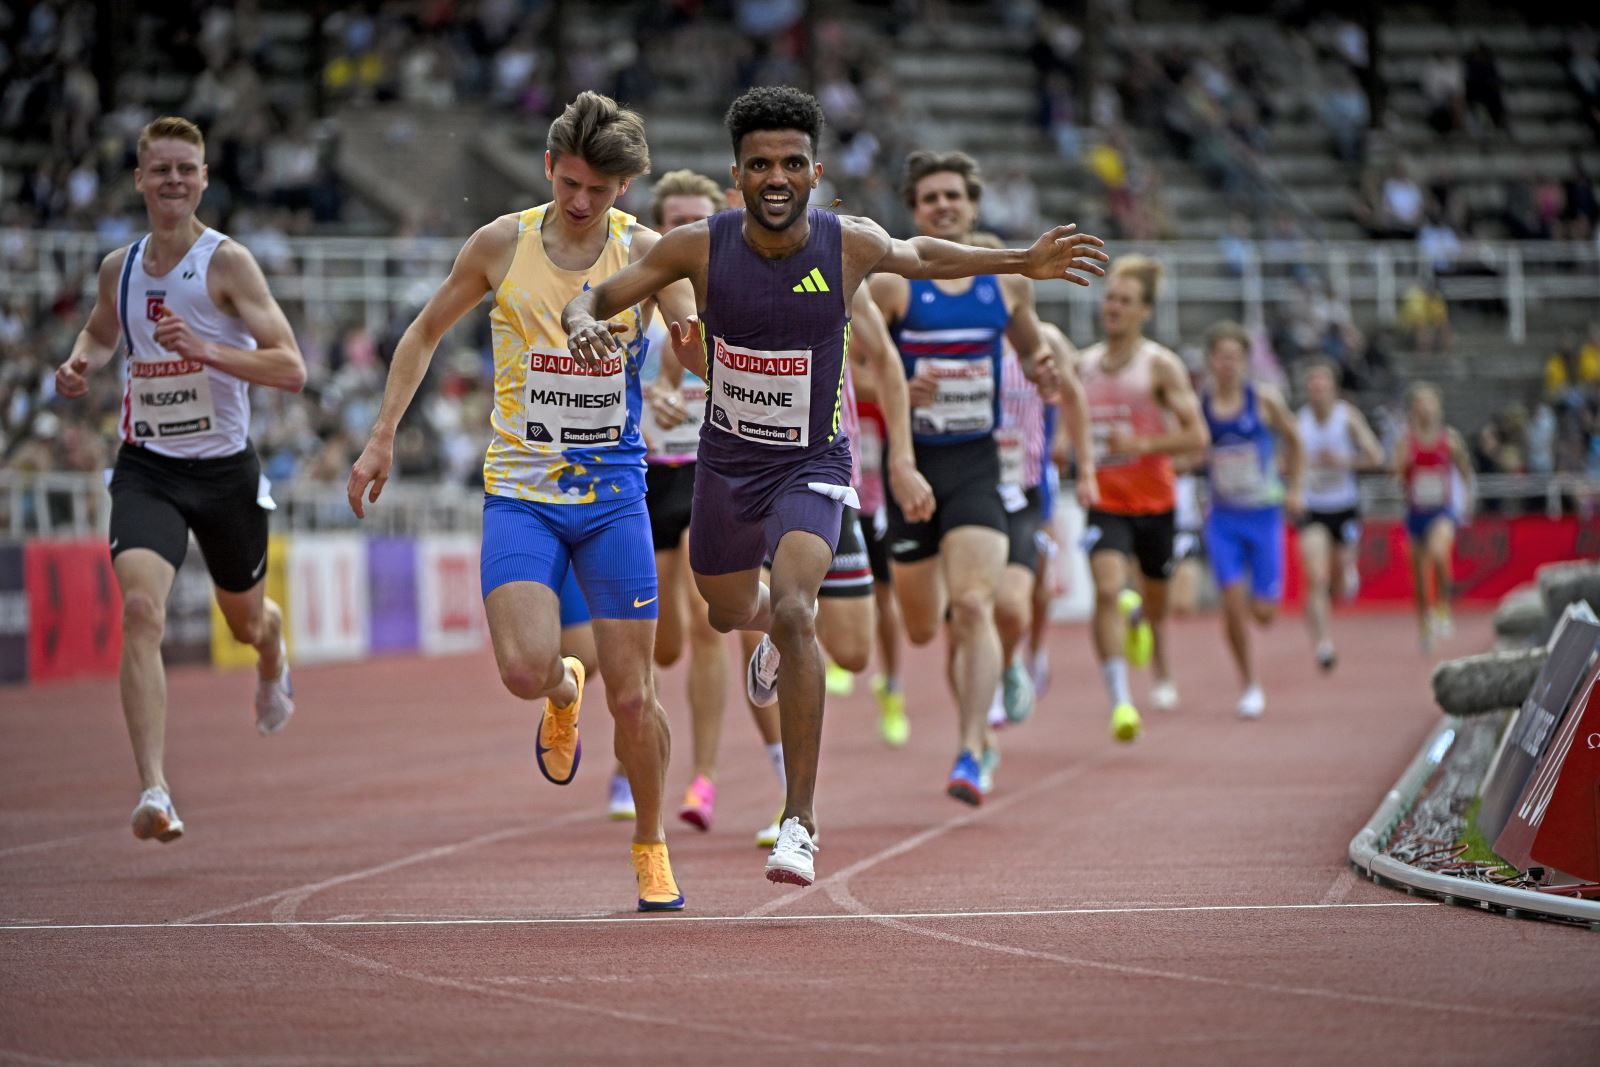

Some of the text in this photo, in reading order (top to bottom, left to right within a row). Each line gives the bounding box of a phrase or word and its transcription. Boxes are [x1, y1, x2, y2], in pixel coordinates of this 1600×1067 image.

[717, 346, 807, 375] BAUHAUS
[140, 388, 198, 407] NILSSON
[530, 389, 621, 409] MATHIESEN
[722, 380, 793, 407] BRHANE
[563, 431, 607, 441] Sundström
[741, 424, 786, 439] Sundström
